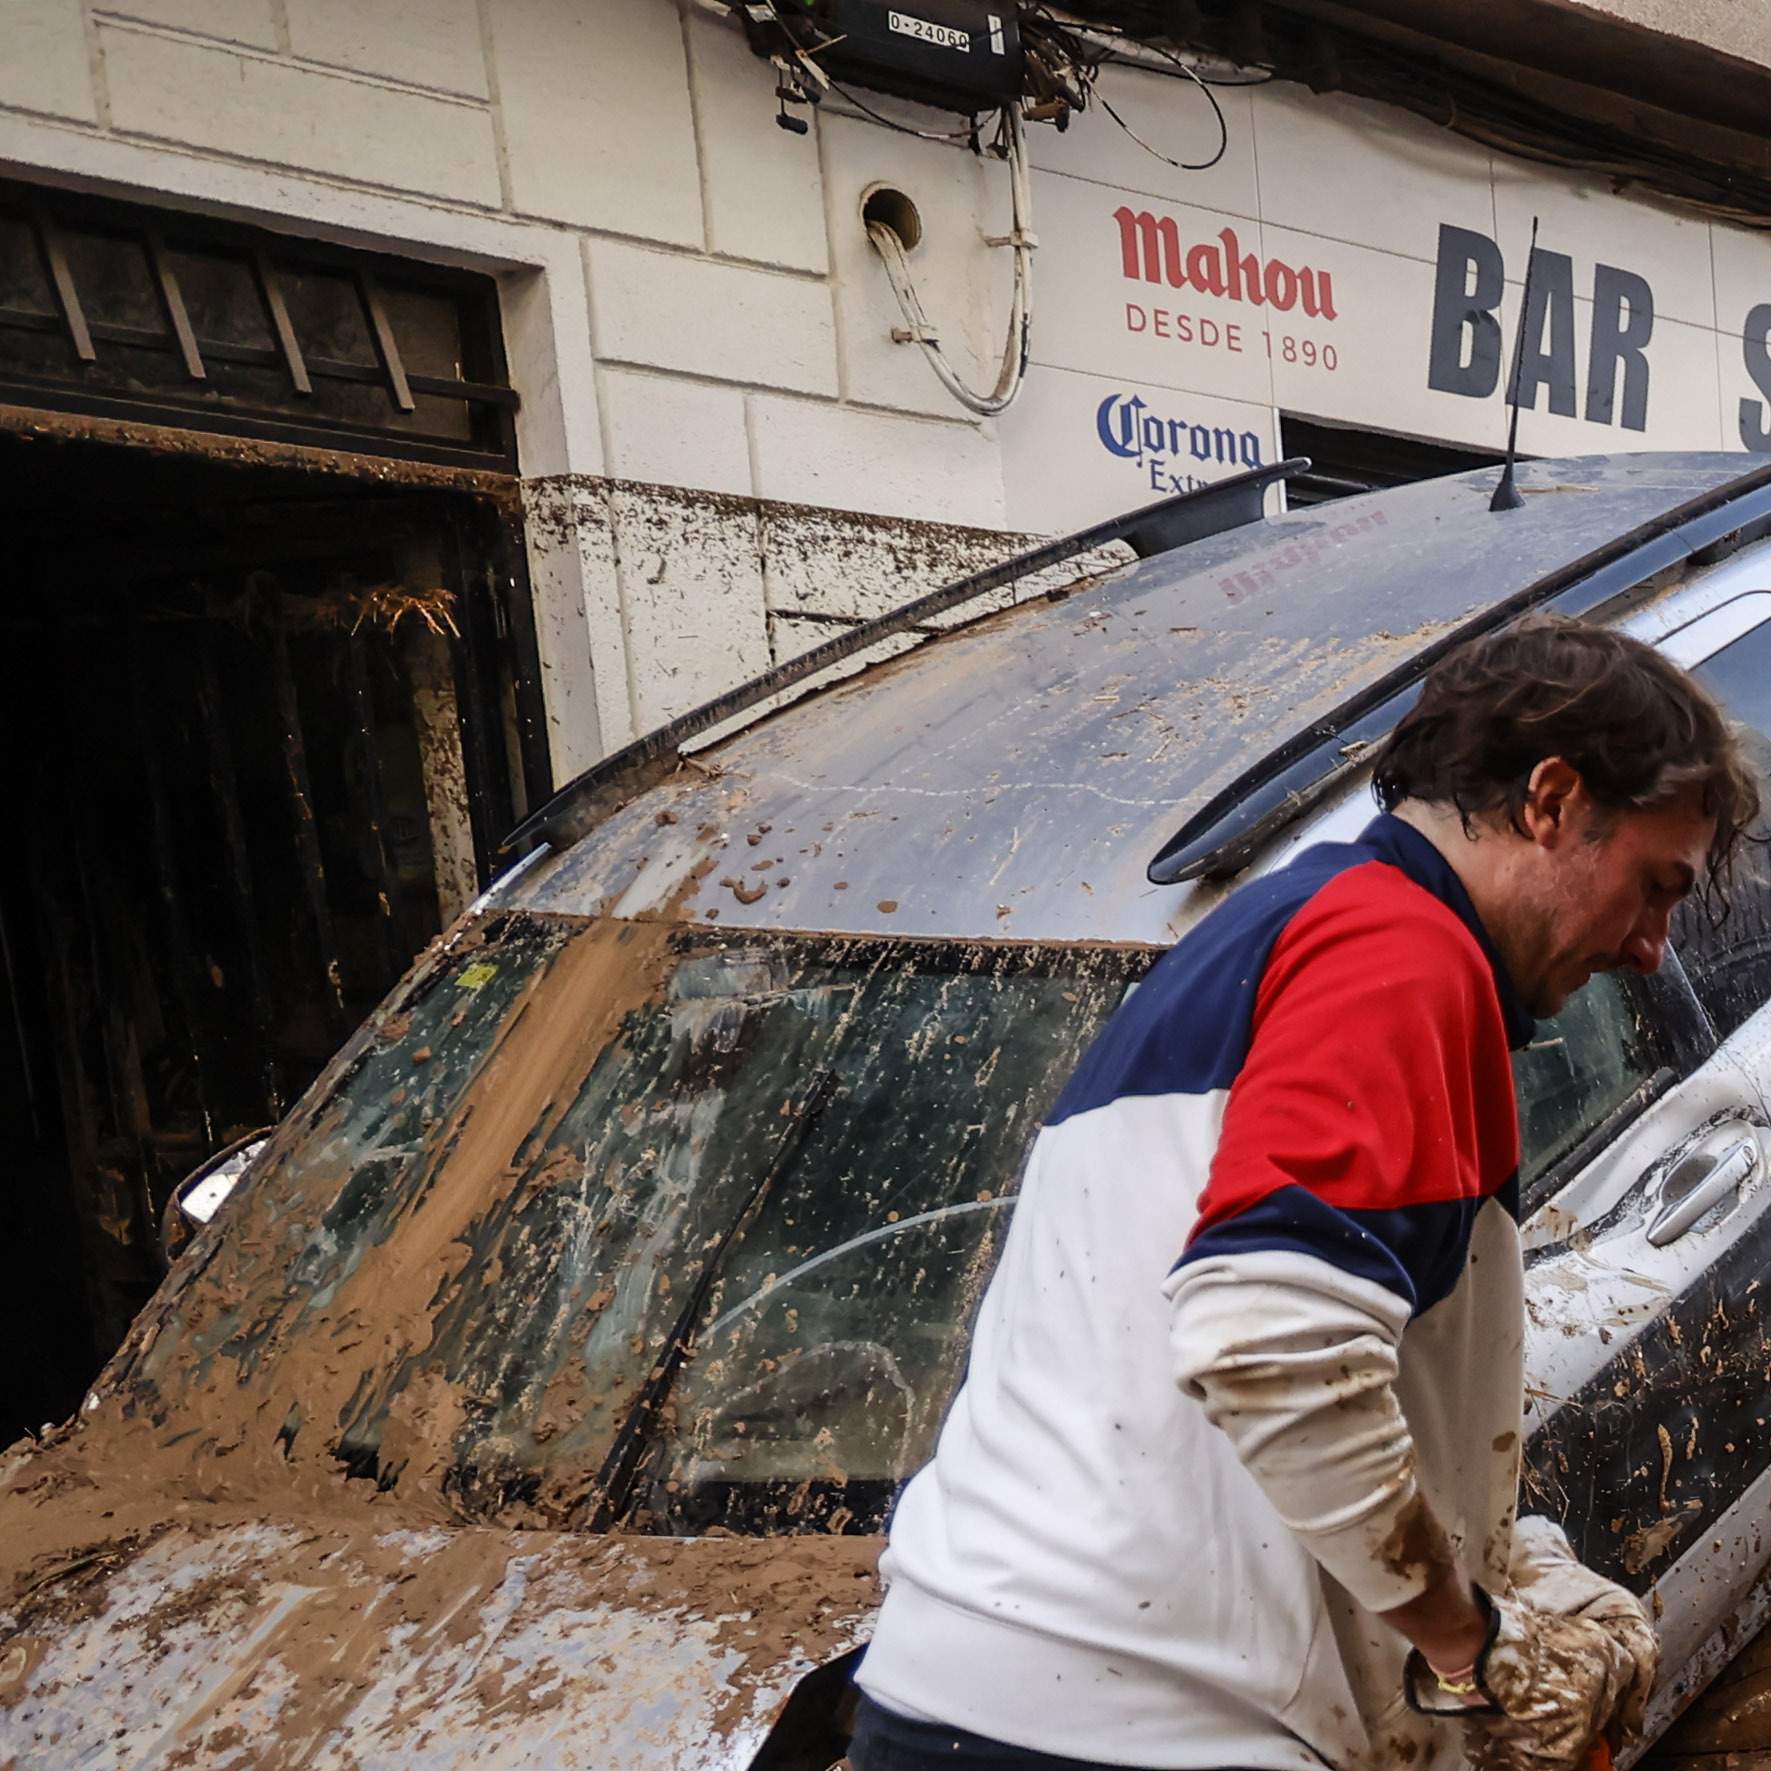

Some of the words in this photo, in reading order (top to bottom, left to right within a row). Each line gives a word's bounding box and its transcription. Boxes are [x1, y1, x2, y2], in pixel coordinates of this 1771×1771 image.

[1112, 206, 1338, 321] Mahou
[1126, 303, 1242, 352] DESDE
[1262, 331, 1338, 371] 1890
[1427, 222, 1654, 433] BAR
[1096, 393, 1265, 469] Corona
